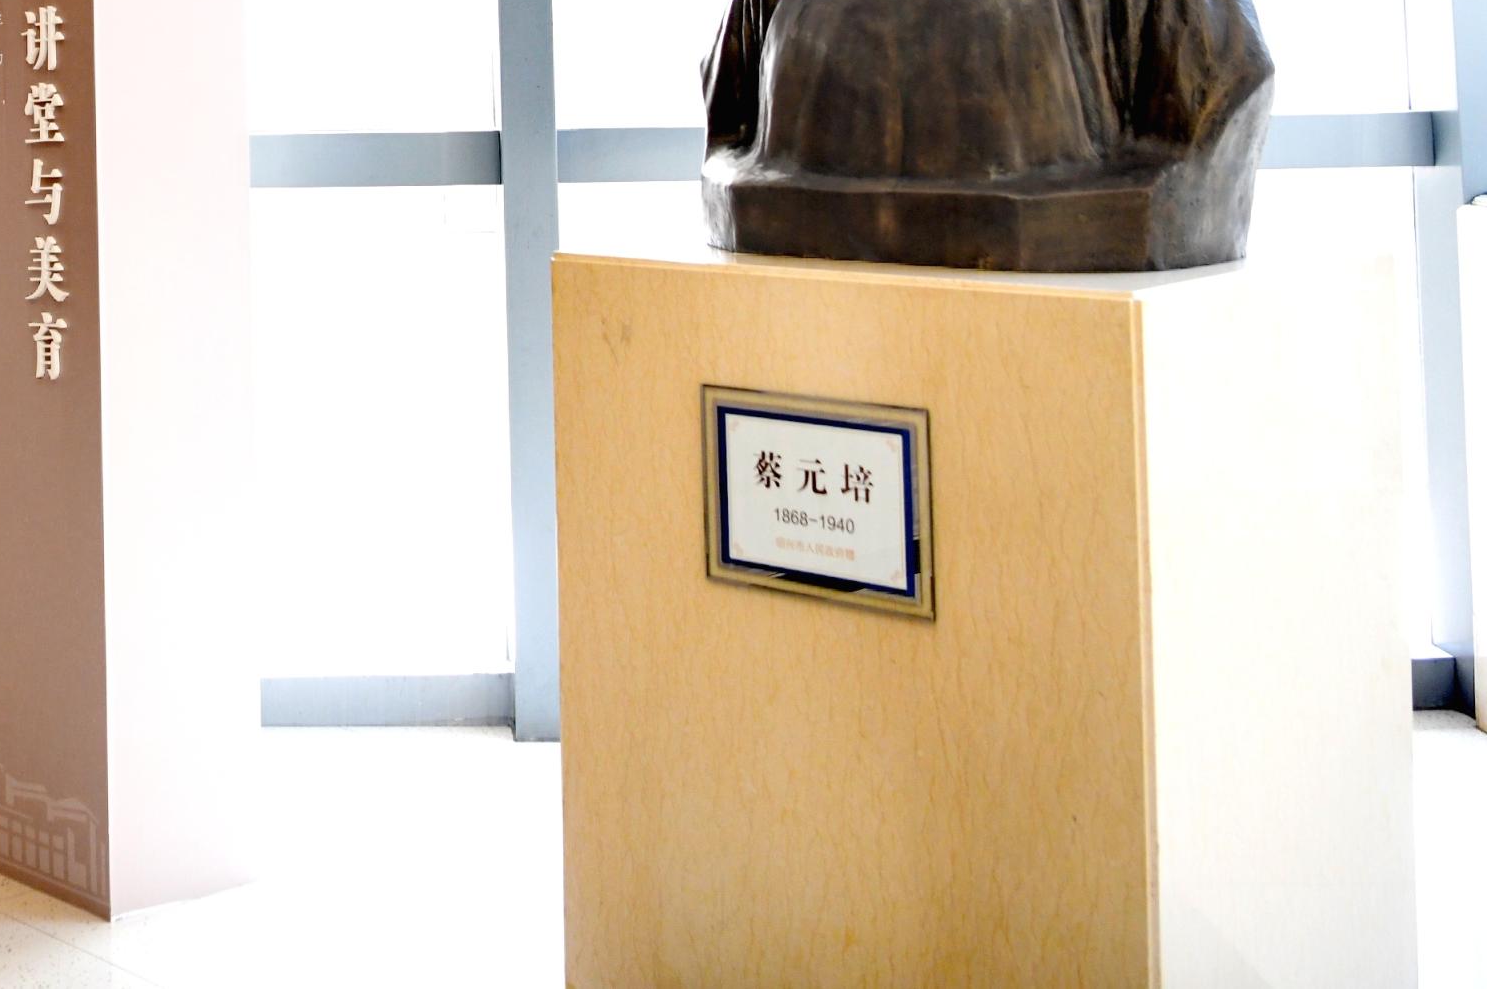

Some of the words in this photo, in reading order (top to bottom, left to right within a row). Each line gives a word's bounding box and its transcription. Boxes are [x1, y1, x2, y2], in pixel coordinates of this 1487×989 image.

[754, 450, 874, 504] 蔡元培
[773, 507, 855, 534] 1868-1940
